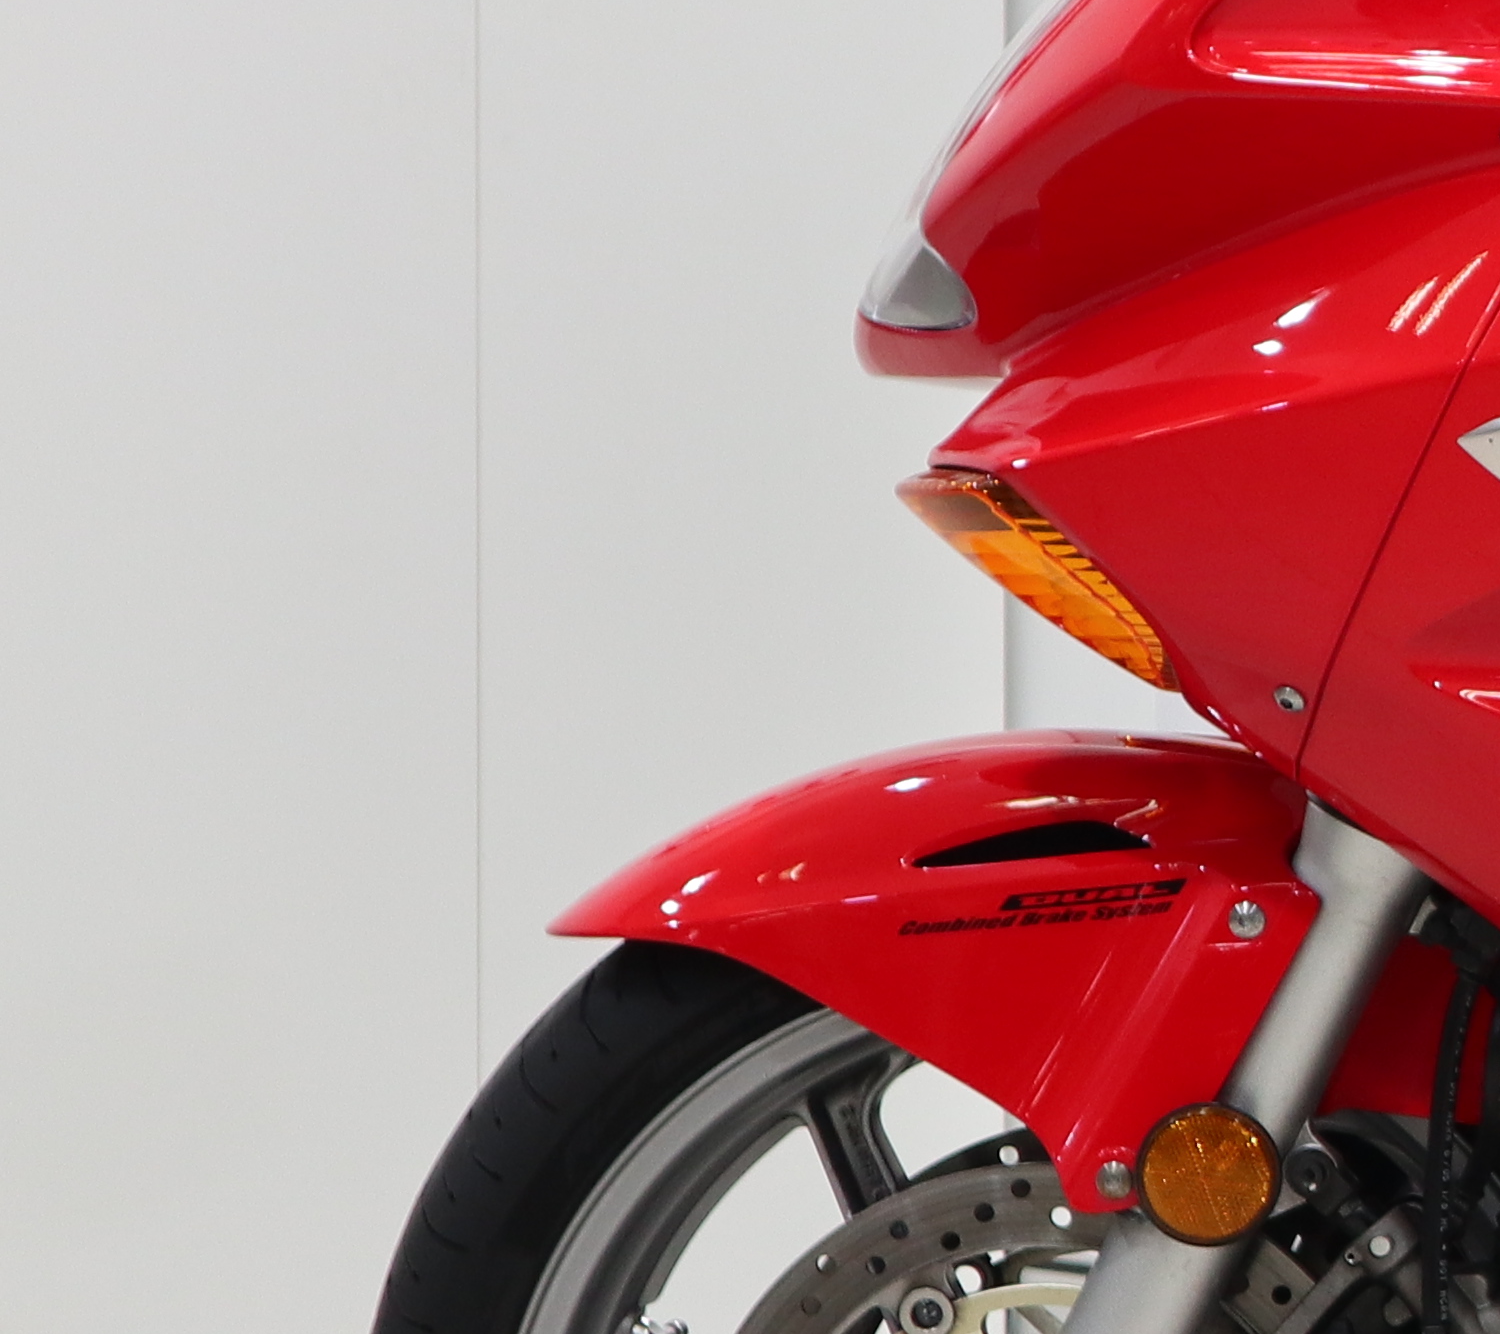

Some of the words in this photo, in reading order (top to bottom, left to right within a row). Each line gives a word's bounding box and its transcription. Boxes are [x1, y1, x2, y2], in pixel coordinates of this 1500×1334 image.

[1017, 882, 1172, 908] DUAL
[898, 914, 1017, 936] Combined
[1019, 908, 1088, 927] Brake
